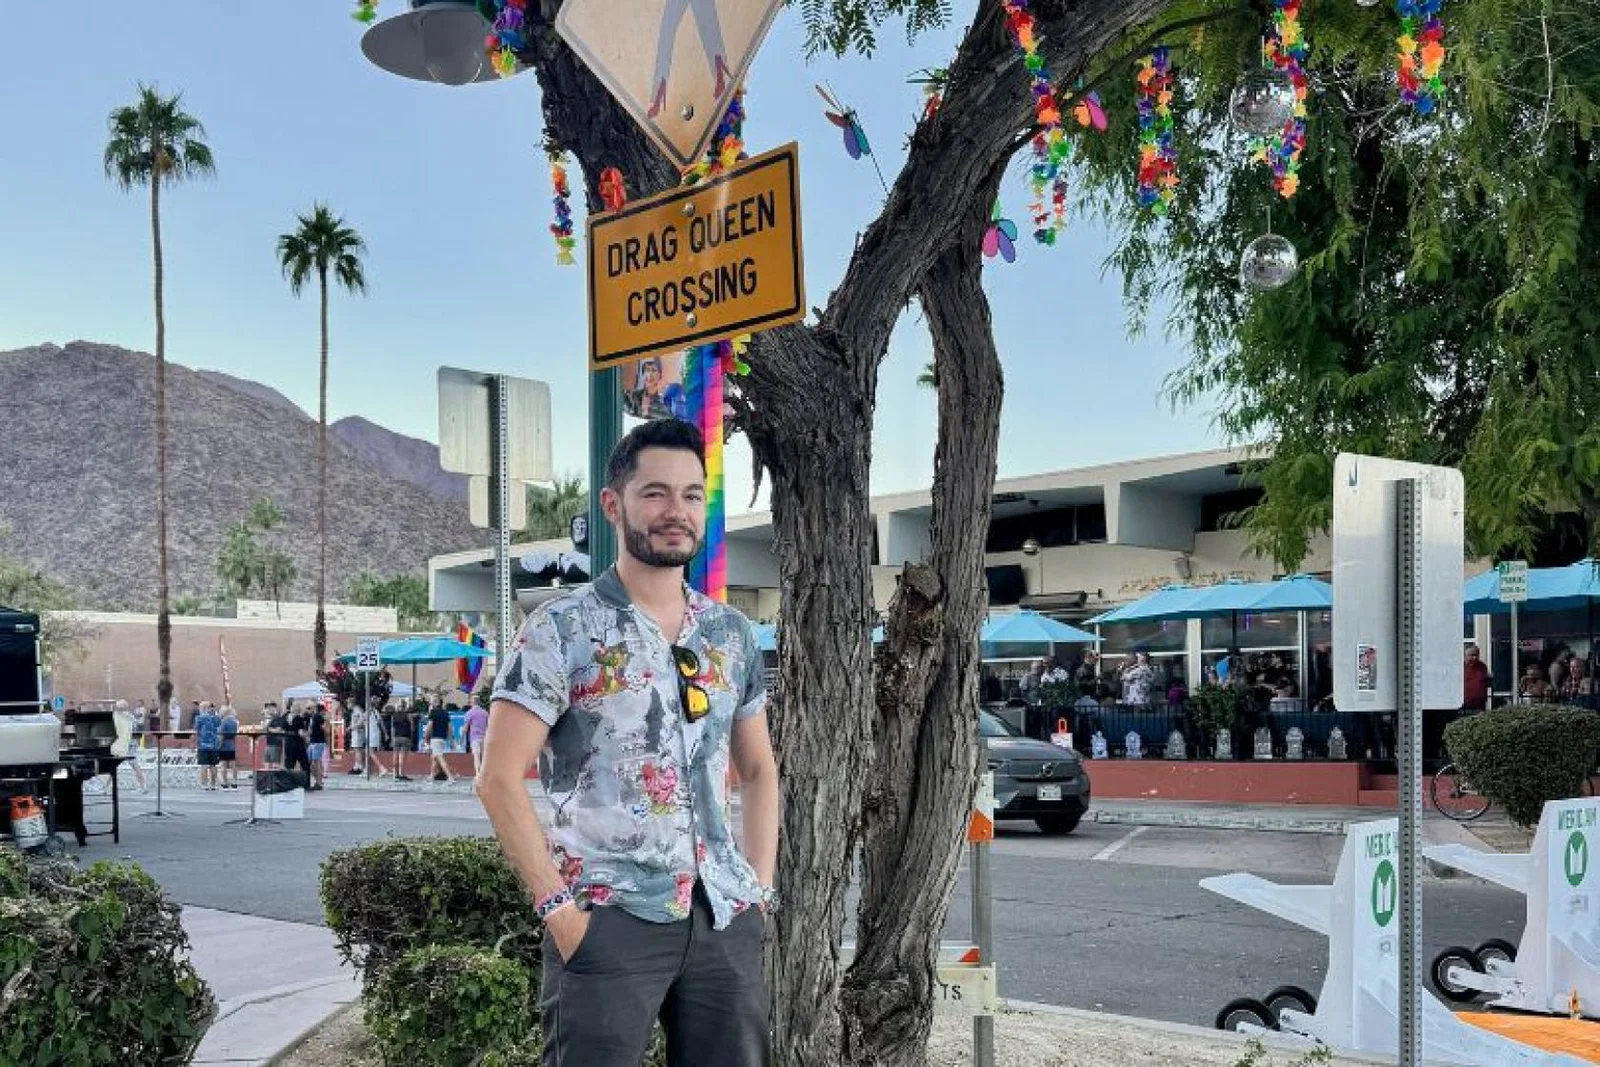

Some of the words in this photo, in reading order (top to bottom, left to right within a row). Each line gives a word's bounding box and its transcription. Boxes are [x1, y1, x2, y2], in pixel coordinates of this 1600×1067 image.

[608, 225, 678, 278] DRAG
[690, 189, 775, 253] QUEEN
[628, 257, 757, 326] CROSSING
[359, 653, 377, 666] 25
[939, 983, 961, 1000] TS
